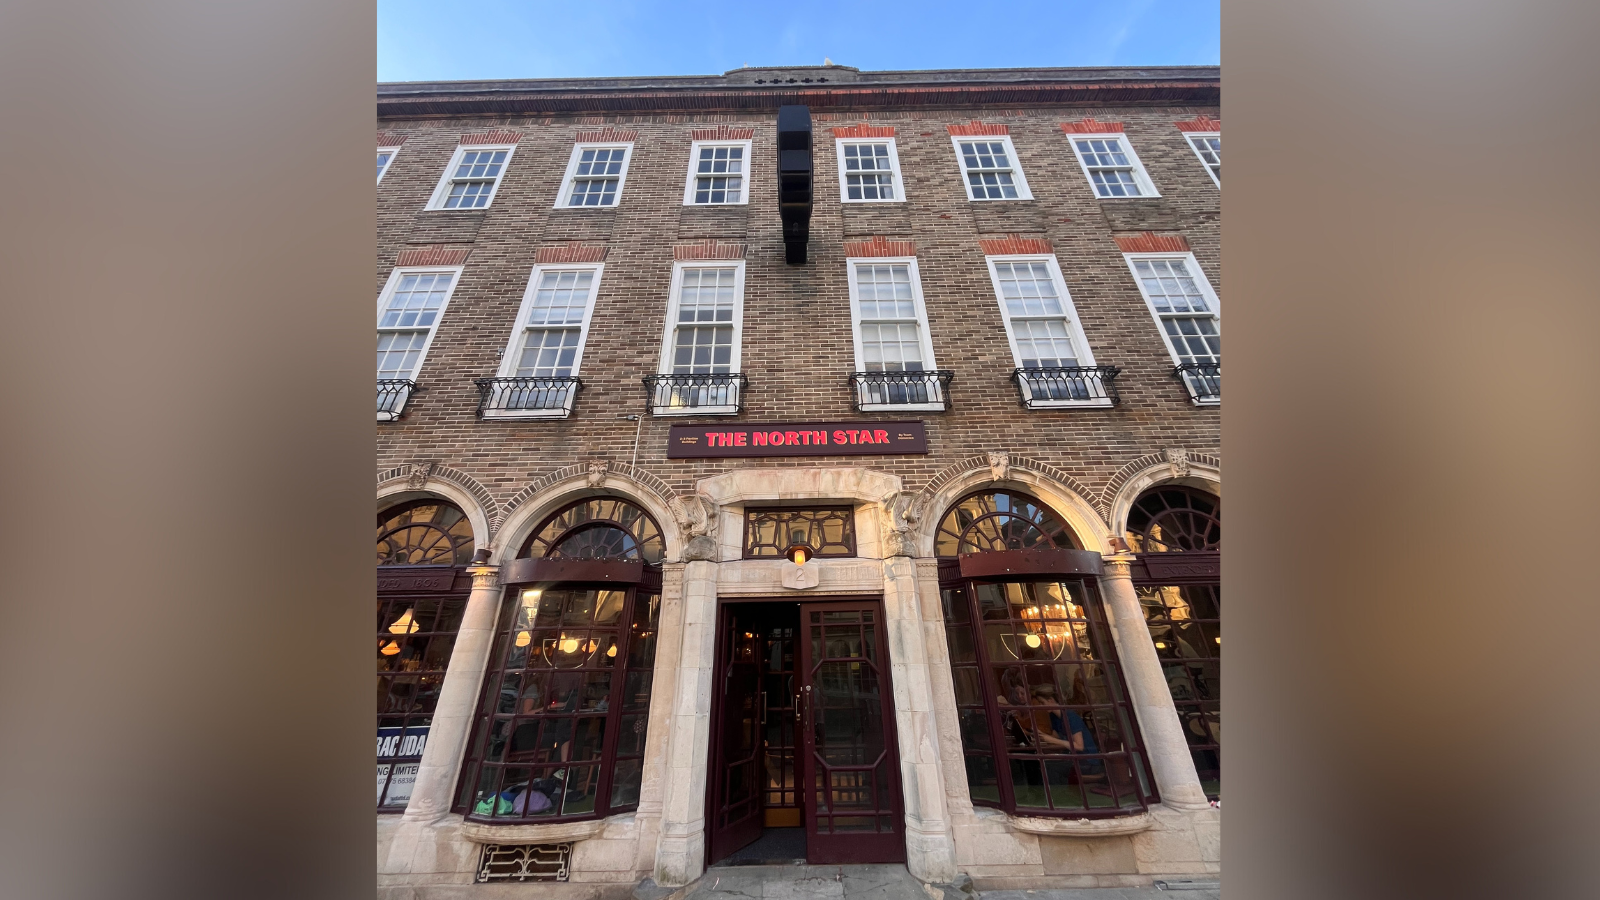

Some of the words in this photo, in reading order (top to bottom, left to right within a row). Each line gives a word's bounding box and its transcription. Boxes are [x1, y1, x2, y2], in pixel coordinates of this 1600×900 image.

[705, 431, 747, 447] THE
[752, 430, 828, 446] NORTH
[833, 429, 890, 445] STAR
[796, 568, 804, 581] 2
